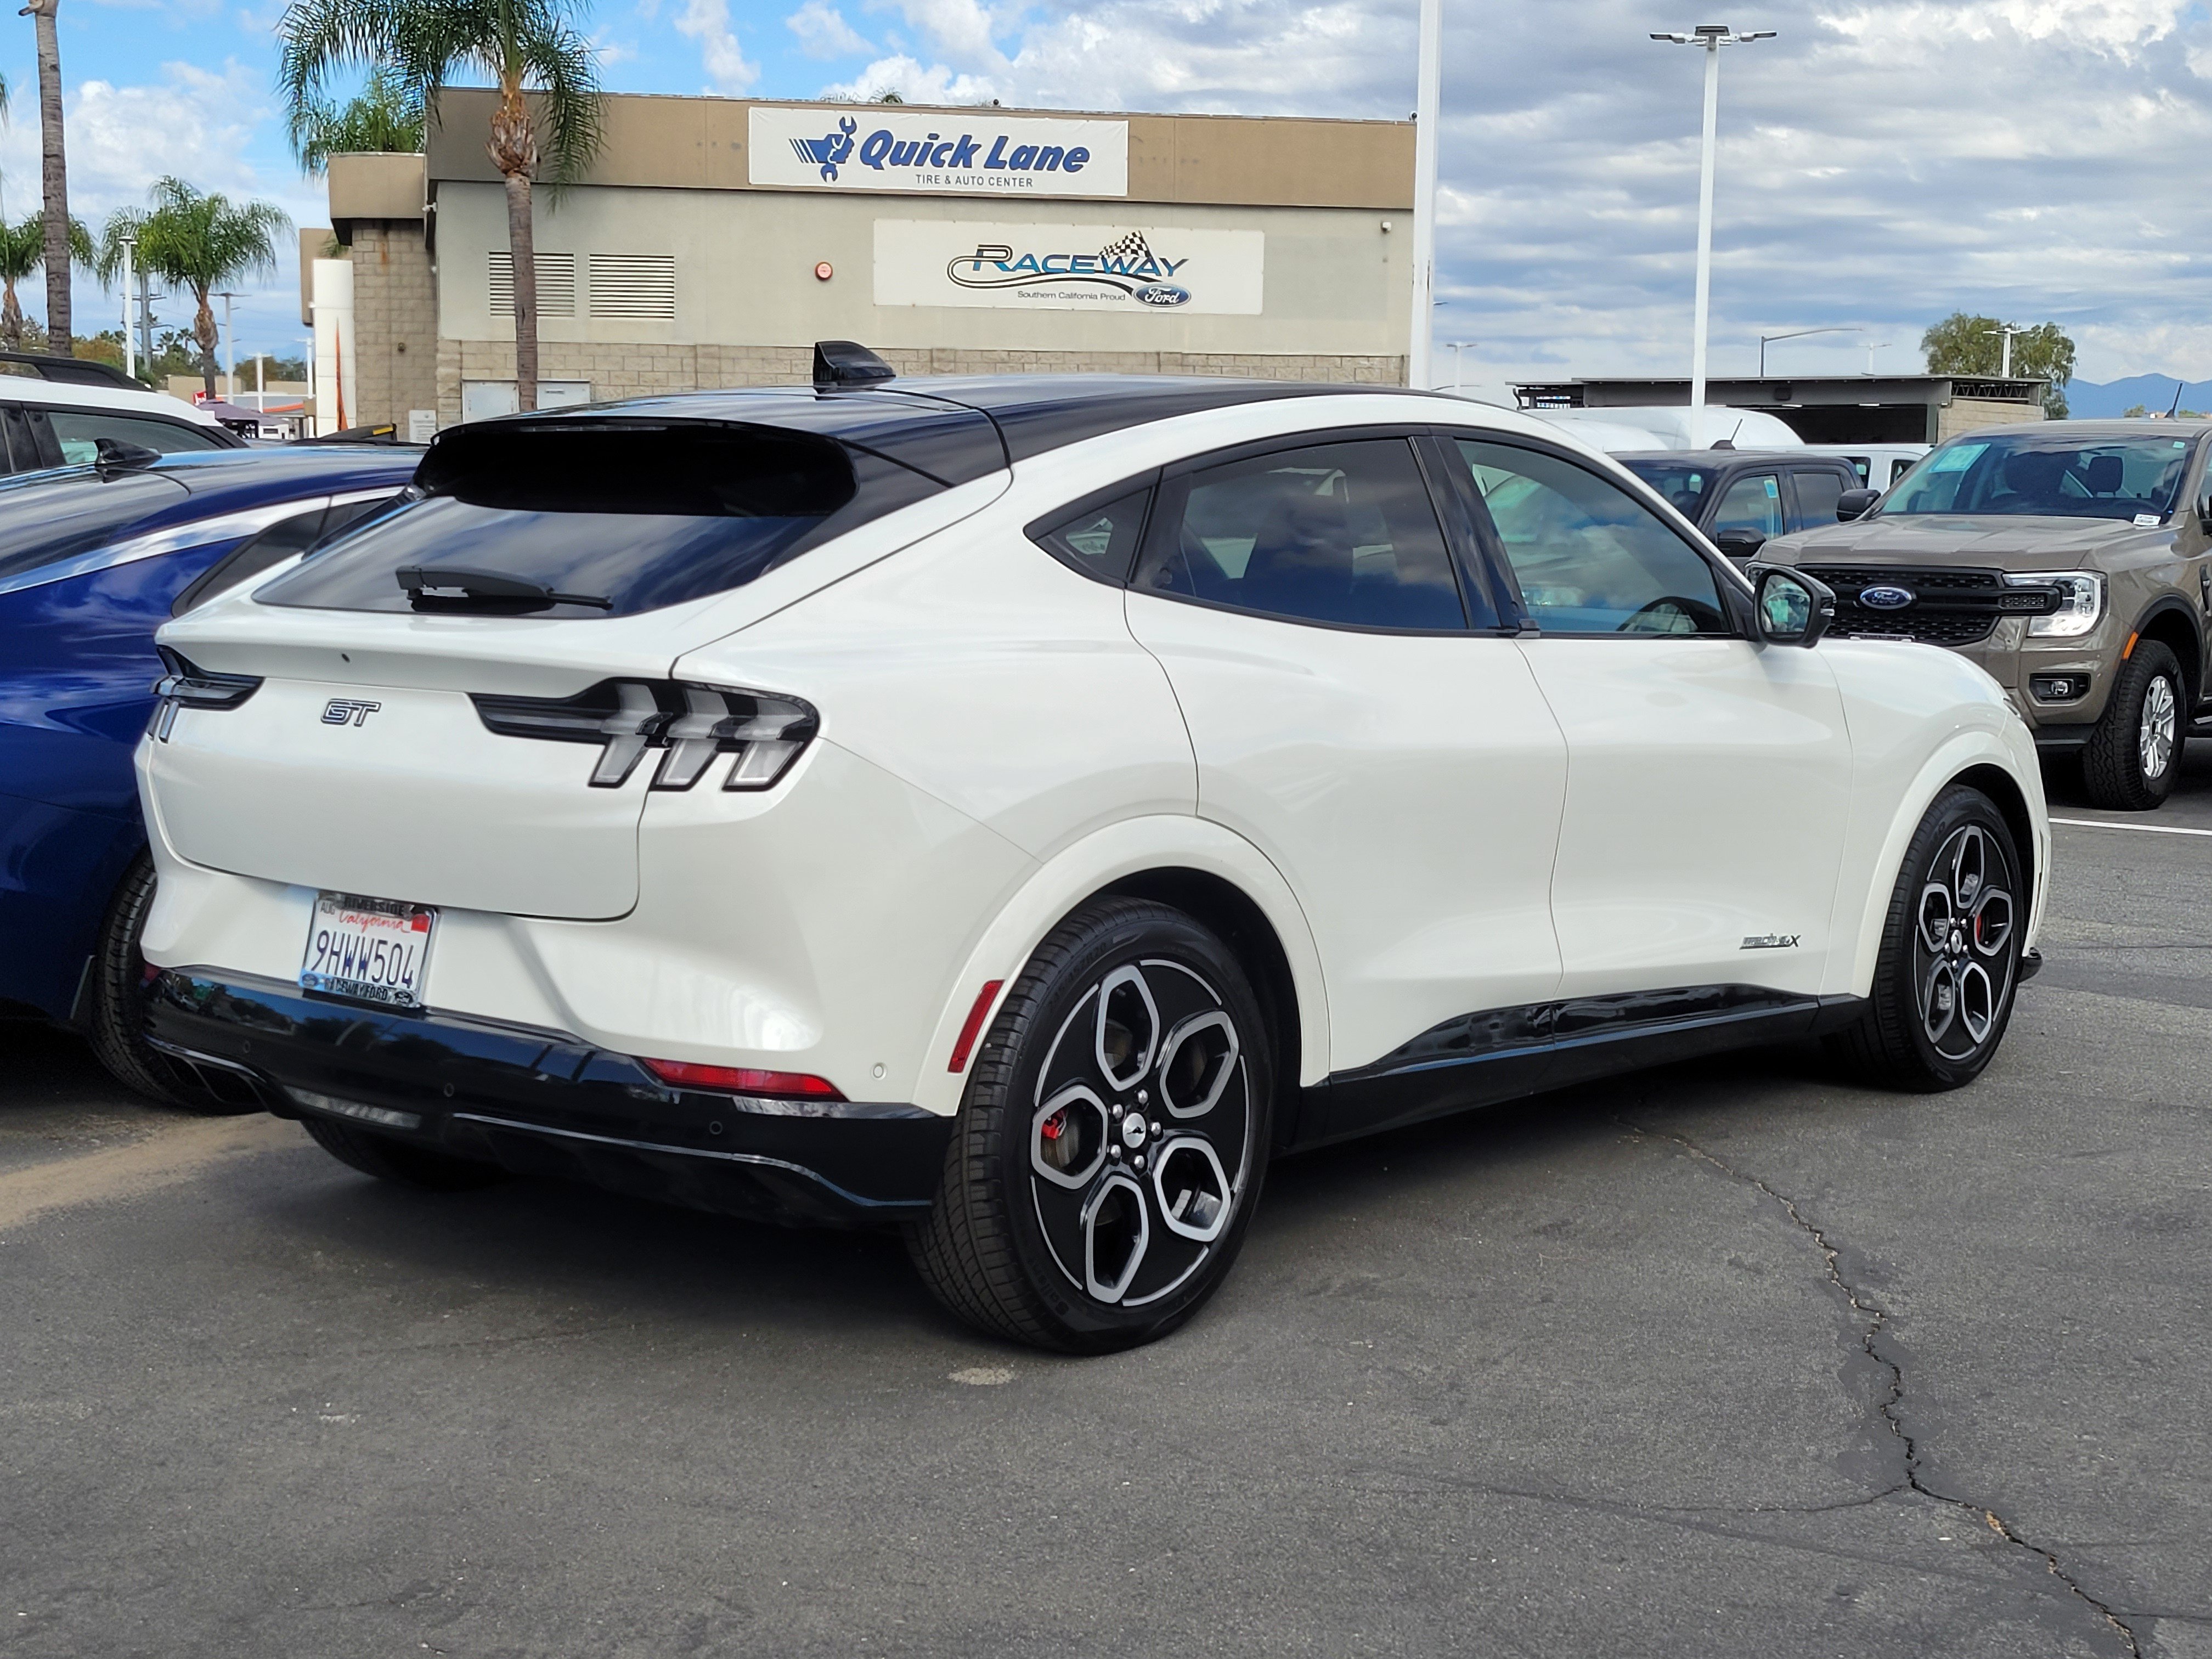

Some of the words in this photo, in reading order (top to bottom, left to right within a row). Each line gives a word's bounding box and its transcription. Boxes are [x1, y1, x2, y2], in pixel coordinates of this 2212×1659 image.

[860, 129, 982, 170] Quick
[984, 135, 1091, 173] Lane
[916, 174, 940, 184] TIRE
[944, 175, 951, 185] &
[955, 176, 984, 186] AUTO
[988, 176, 1033, 188] CENTER
[972, 244, 1189, 276] RACEWAY
[1018, 290, 1057, 299] Southern
[1058, 291, 1098, 300] California
[1100, 292, 1126, 301] Proud
[1144, 286, 1180, 304] Ford
[320, 698, 382, 727] GT
[339, 910, 410, 933] California
[311, 930, 414, 989] 9HWW504
[363, 985, 388, 1001] FORD
